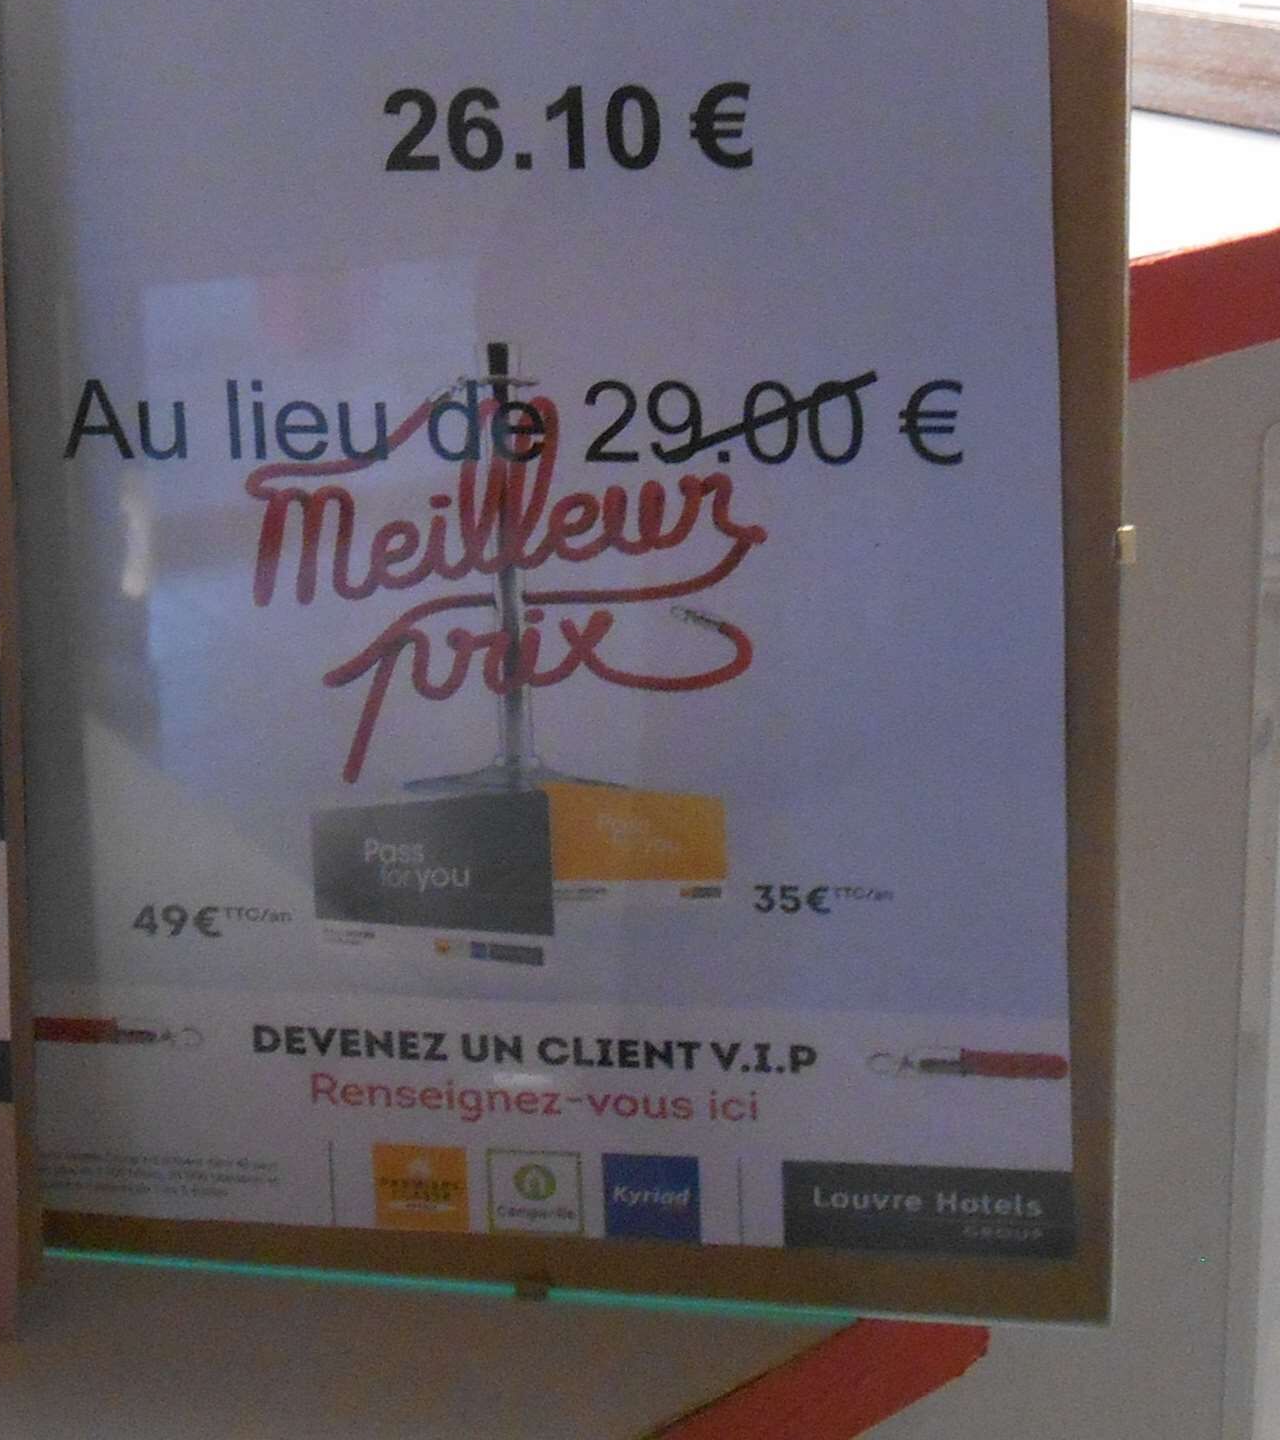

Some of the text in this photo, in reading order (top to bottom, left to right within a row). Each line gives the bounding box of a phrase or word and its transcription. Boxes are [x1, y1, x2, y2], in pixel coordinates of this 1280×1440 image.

[383, 81, 753, 172] 26.10 €
[63, 374, 963, 466] Au lieu de 29.00 €
[246, 395, 767, 607] Meilleur
[323, 592, 753, 784] prix
[364, 837, 424, 864] Pass
[132, 903, 223, 938] 49€
[754, 885, 832, 915] 35€
[252, 1024, 817, 1074] DEVENEZ UN CLIENT V.I.P
[310, 1073, 759, 1122] Renseignez-vous ici
[613, 1185, 690, 1208] Kyriad
[814, 1185, 1043, 1218] Louvre Hotels
